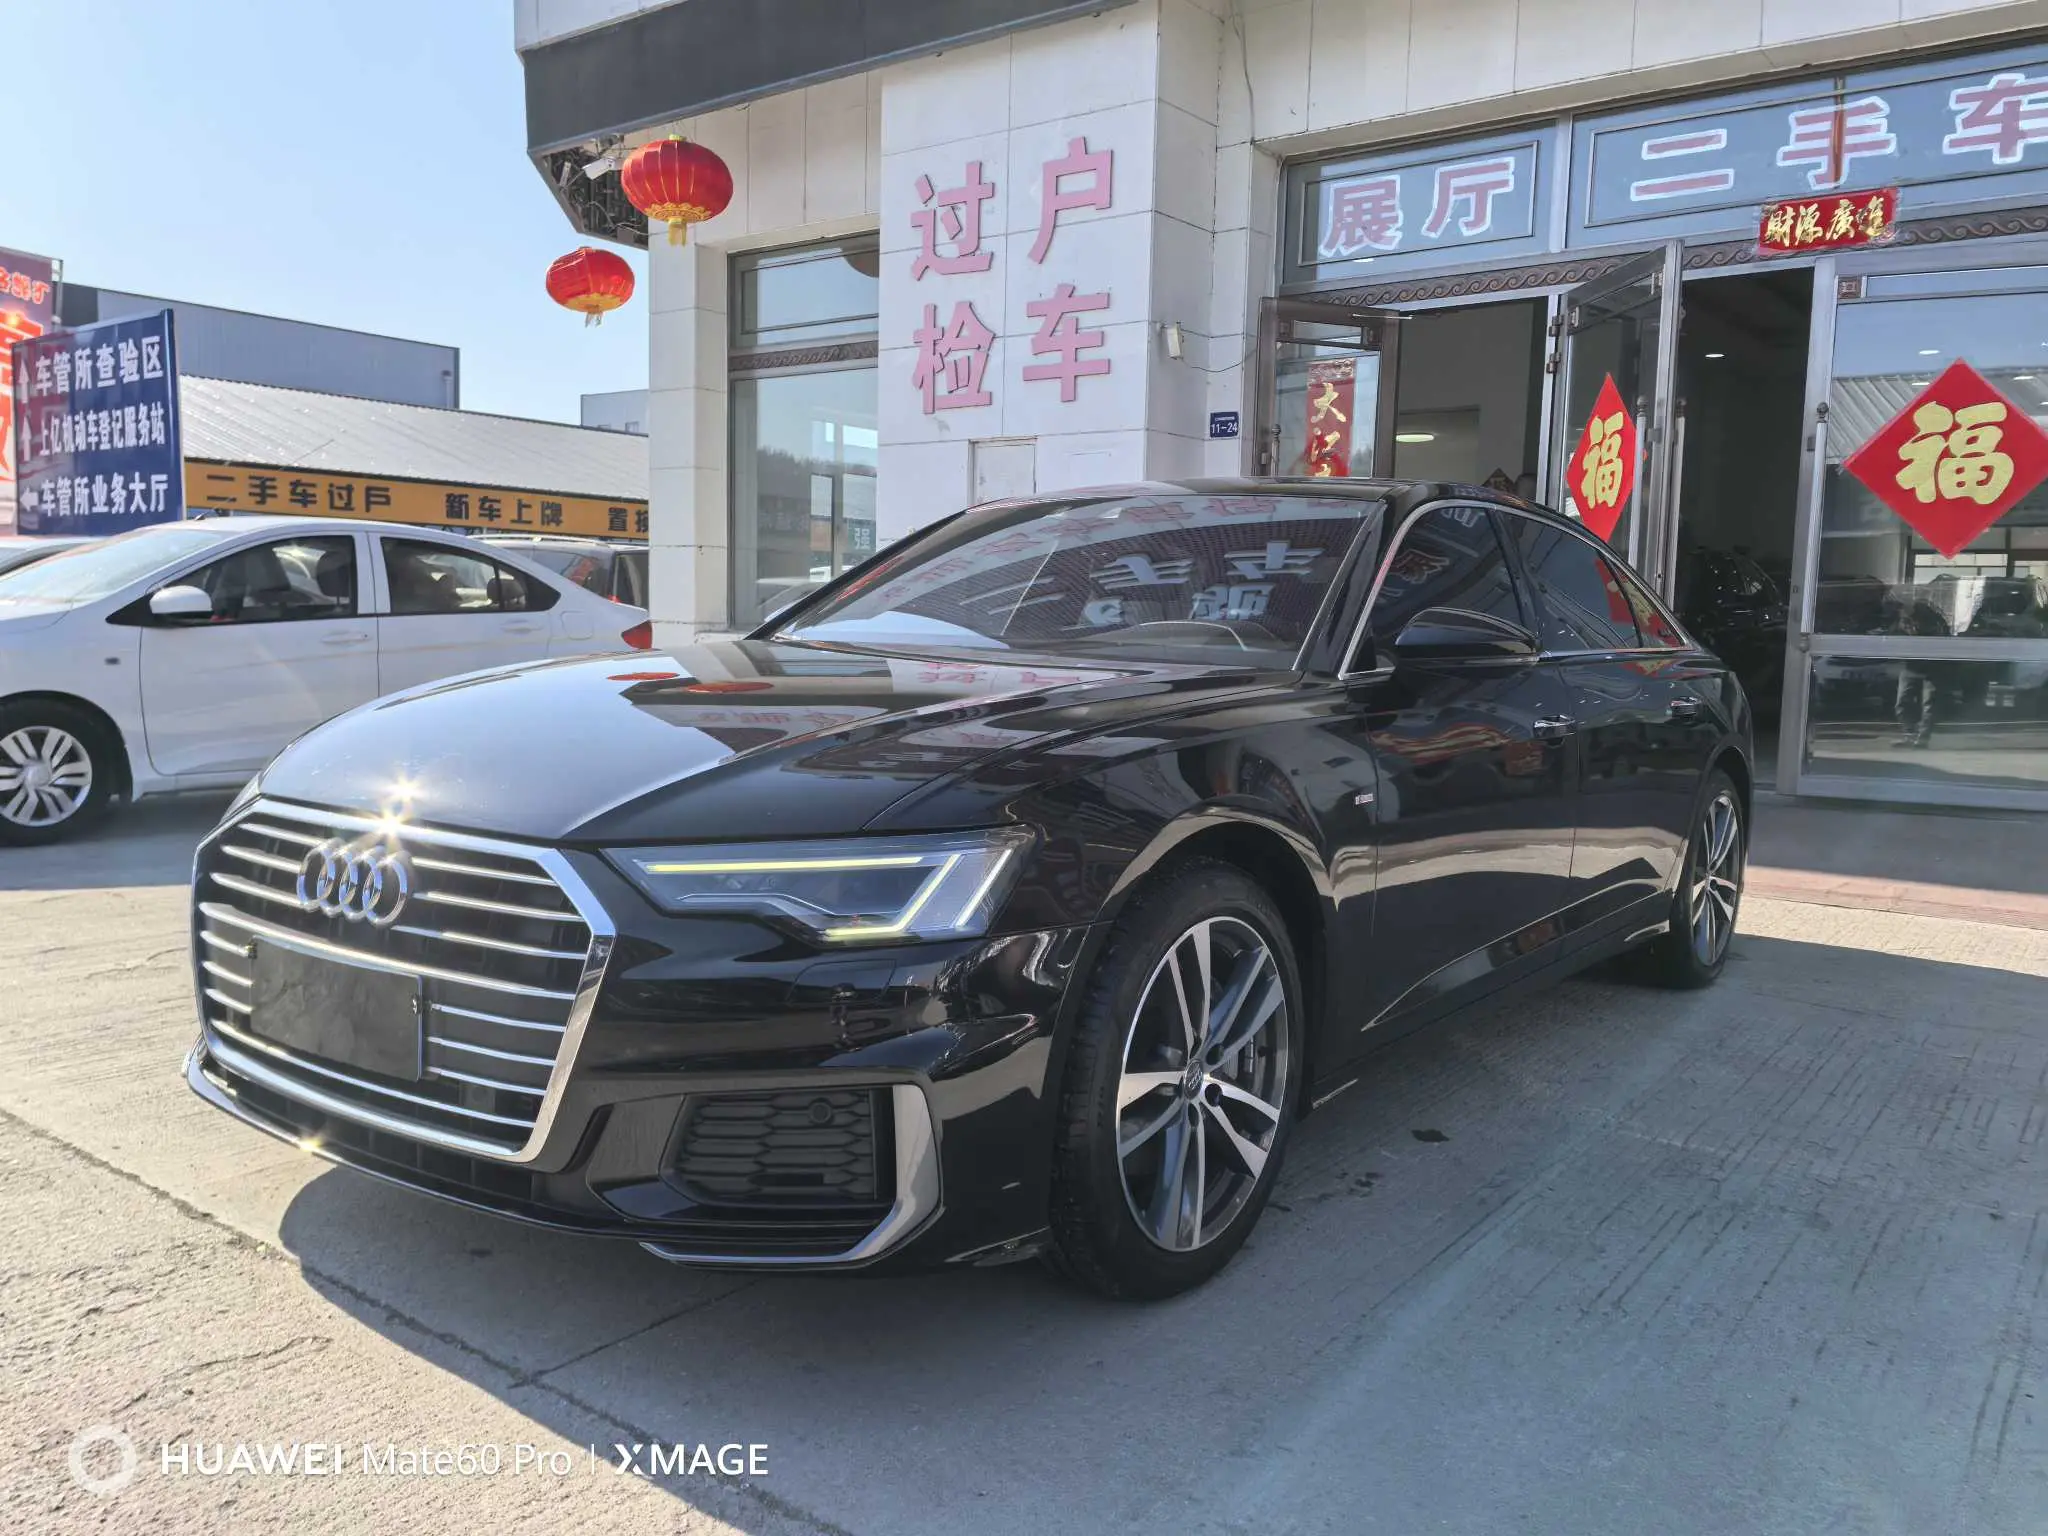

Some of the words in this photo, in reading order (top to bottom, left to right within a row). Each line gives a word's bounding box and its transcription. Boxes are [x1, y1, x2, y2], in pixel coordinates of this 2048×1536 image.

[1320, 156, 1515, 256] 展厅
[1630, 72, 2048, 202] 二手车
[909, 136, 1113, 281] 过户
[35, 336, 163, 396] 车管所查验区
[911, 283, 1111, 415] 检车
[39, 400, 166, 457] 上亿机动车登记服务站
[1211, 422, 1238, 434] 11-24
[1581, 411, 1625, 510] 福
[1895, 401, 2015, 505] 福
[41, 470, 169, 518] 车管所业务大厅
[207, 474, 391, 513] 二手车过户
[446, 493, 564, 527] 新车上牌
